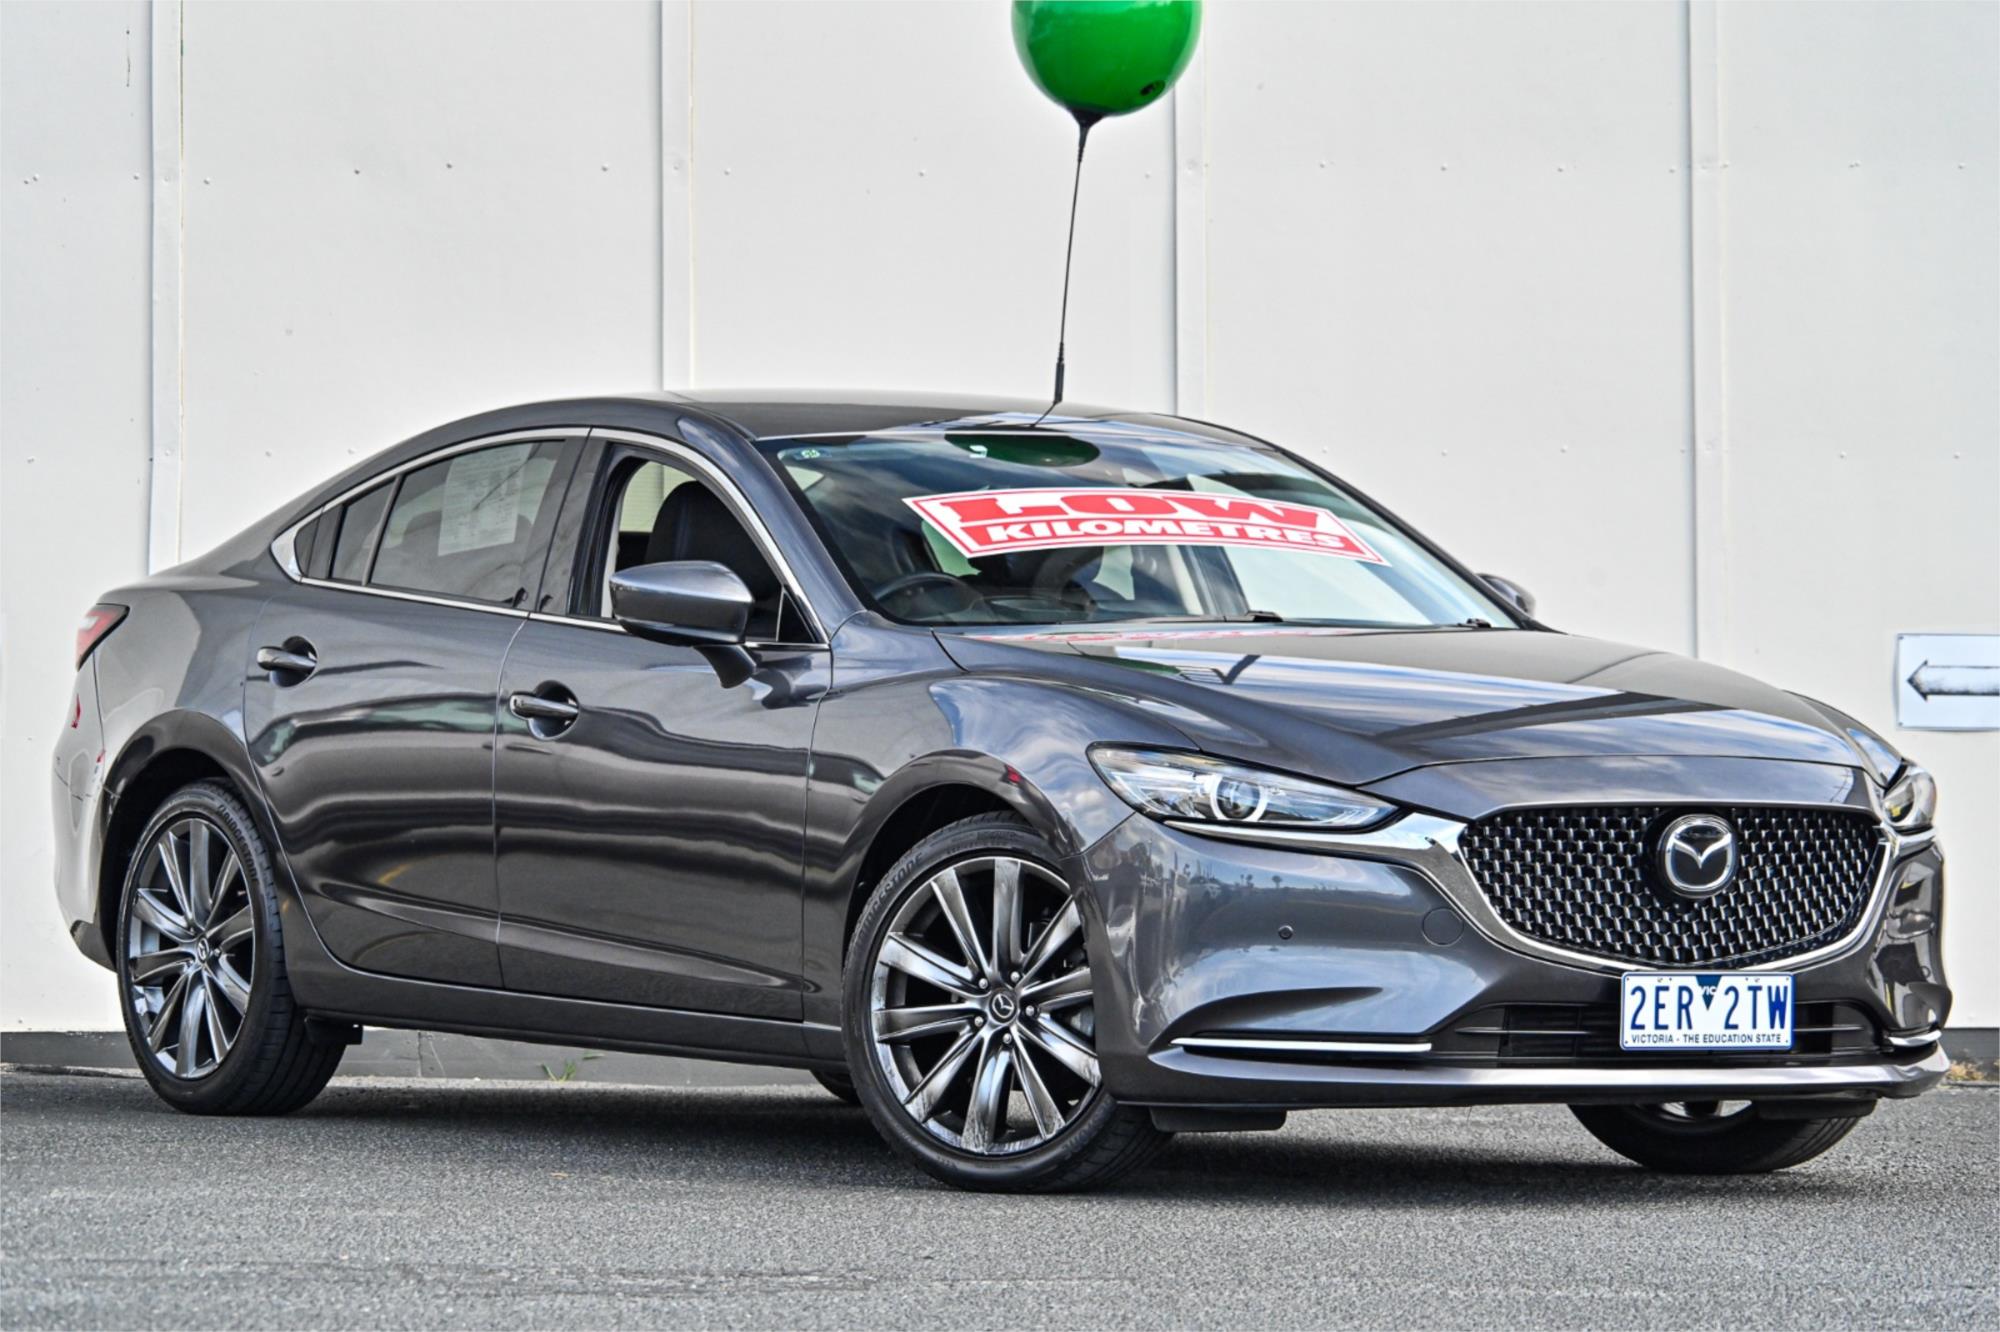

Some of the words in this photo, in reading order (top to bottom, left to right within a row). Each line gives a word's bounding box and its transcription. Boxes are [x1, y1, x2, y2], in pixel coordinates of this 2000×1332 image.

[940, 493, 1334, 530] LOW
[986, 518, 1346, 549] KILOMETRES
[1630, 985, 1694, 1030] 2ER
[1723, 985, 1788, 1030] 2TW
[1631, 1034, 1674, 1044] VICTORIA
[1683, 1034, 1700, 1043] THE
[1702, 1034, 1753, 1043] EDUCATION
[1755, 1033, 1781, 1043] STATE
